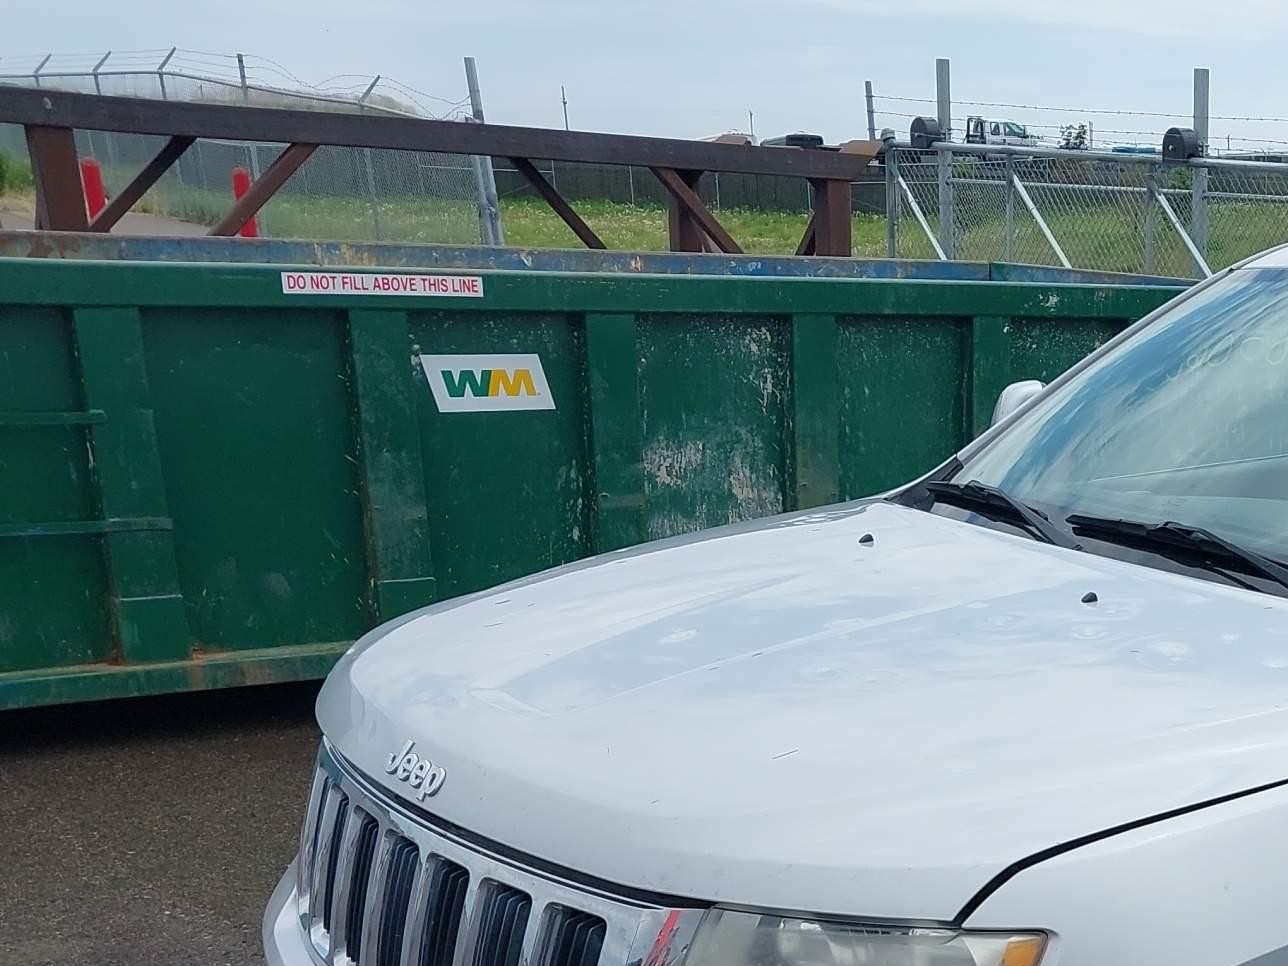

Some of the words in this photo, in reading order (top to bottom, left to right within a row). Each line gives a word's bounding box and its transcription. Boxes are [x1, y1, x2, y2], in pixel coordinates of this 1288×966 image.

[287, 275, 306, 289] DO
[311, 276, 337, 290] NOT
[342, 275, 368, 290] FILL
[373, 276, 416, 292] ABOVE
[421, 278, 449, 293] THIS
[452, 278, 479, 293] LINE
[441, 368, 538, 398] WM
[385, 739, 447, 803] Jeep
